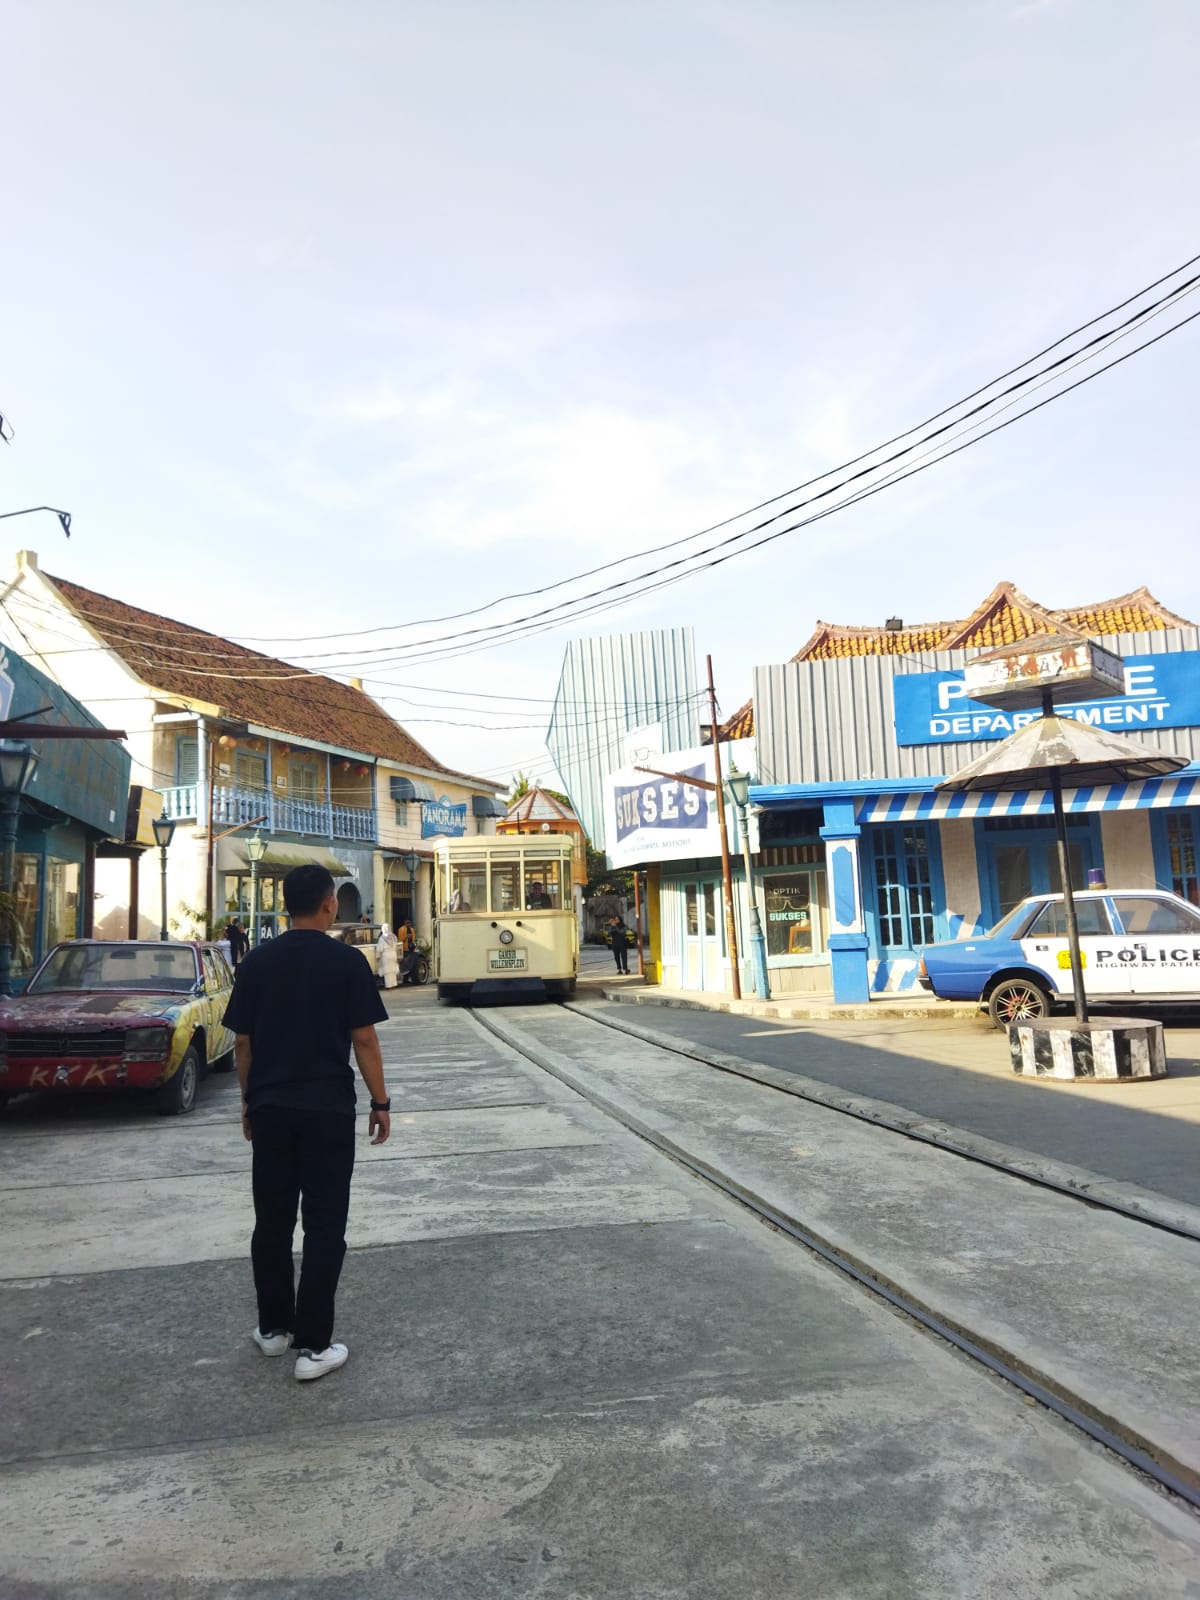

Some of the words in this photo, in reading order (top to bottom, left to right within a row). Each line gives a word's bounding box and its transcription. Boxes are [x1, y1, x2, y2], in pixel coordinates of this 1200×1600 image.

[616, 779, 700, 831] SUKSES
[422, 804, 466, 828] PANORAMA
[773, 887, 801, 895] OPTIK
[769, 911, 807, 921] SUKSES
